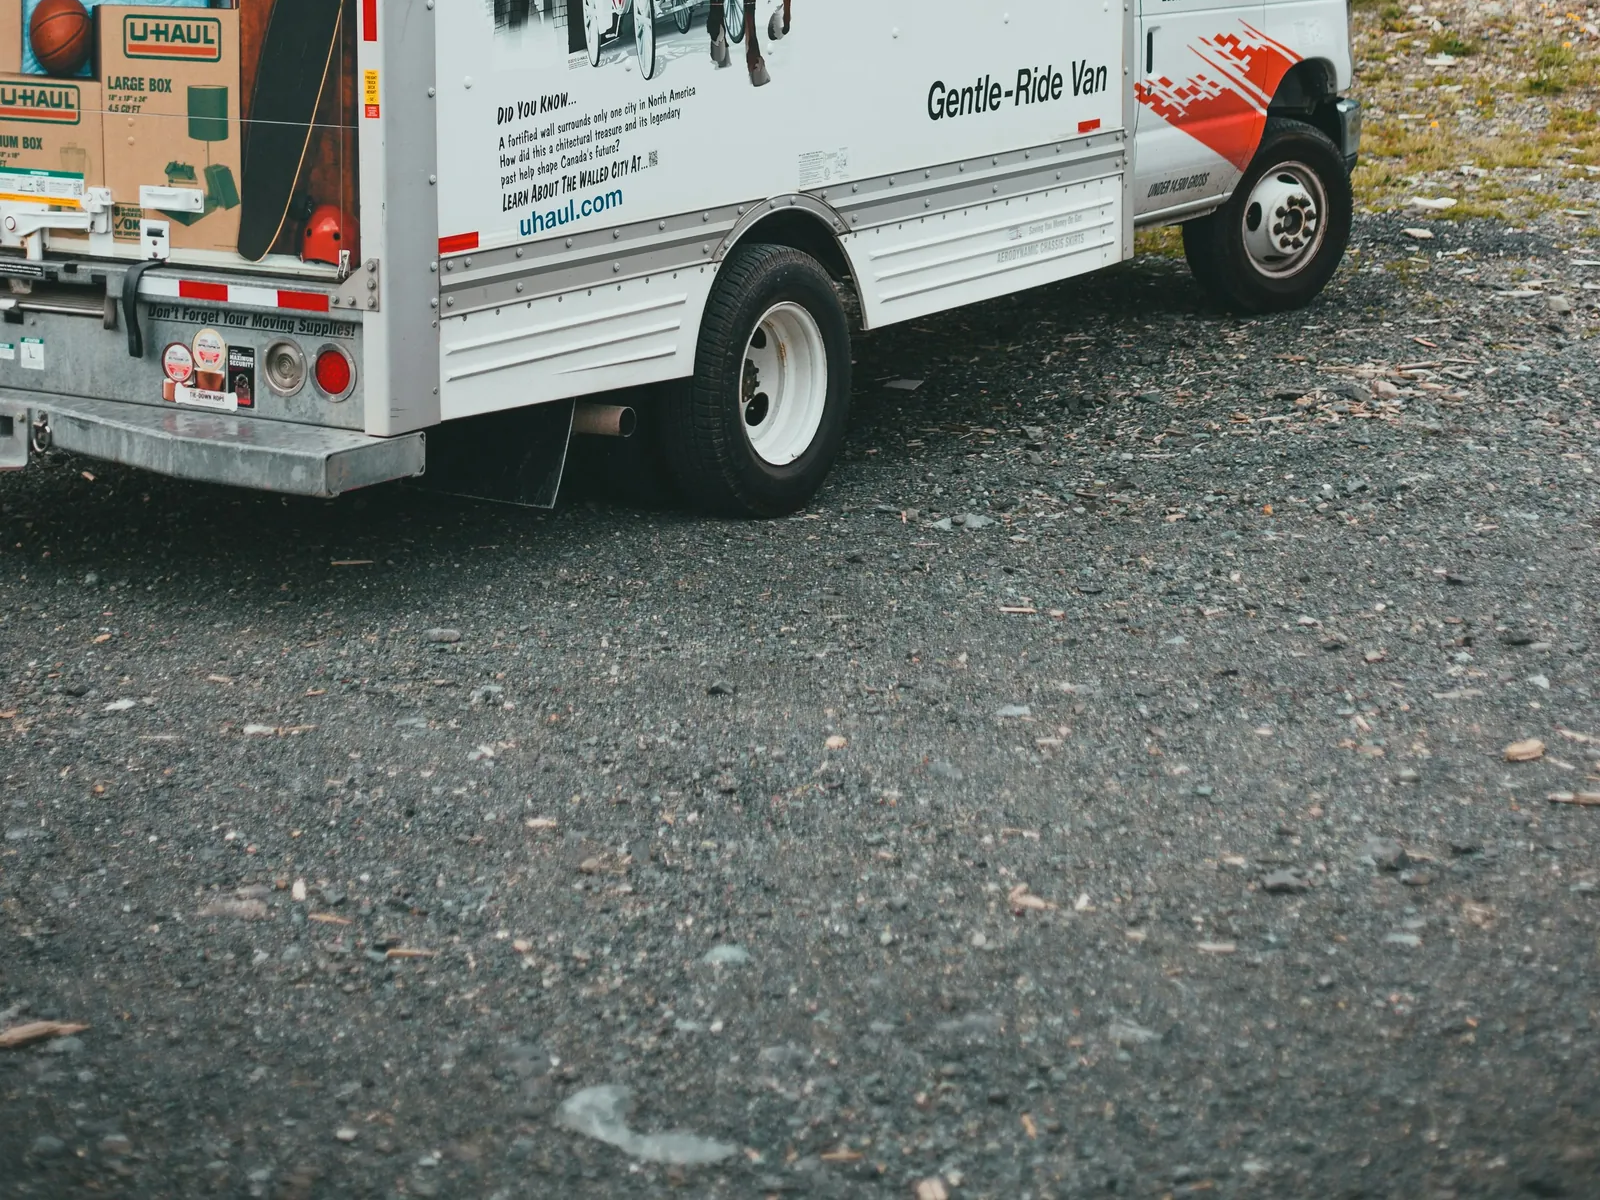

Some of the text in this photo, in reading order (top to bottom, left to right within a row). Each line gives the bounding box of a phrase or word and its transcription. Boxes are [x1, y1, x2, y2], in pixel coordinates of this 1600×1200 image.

[130, 22, 215, 45] U-HAUL
[108, 75, 172, 93] LARGE BOX
[927, 59, 1108, 121] Gentle-Ride Van
[1, 88, 75, 109] U-HAUL
[108, 104, 119, 113] 4.5
[132, 105, 141, 114] FT
[497, 106, 514, 125] DID
[517, 100, 537, 120] YOU
[498, 85, 696, 151] A fortified wall surrounds only one city in North America
[22, 136, 43, 150] BOX
[499, 154, 516, 168] How
[518, 148, 530, 163] did
[532, 145, 546, 159] this
[595, 125, 623, 141] treasure
[625, 120, 637, 132] and
[639, 116, 648, 127] its
[650, 107, 681, 125] legendary
[501, 139, 620, 189] past help shape Canada's future?
[502, 188, 529, 212] LEARN
[531, 180, 559, 203] ABOUT
[561, 175, 577, 194] THE
[579, 166, 609, 189] WALLED
[611, 159, 629, 179] CITY
[1148, 180, 1171, 198] UNDER
[1187, 172, 1210, 189] GROSS
[124, 219, 140, 230] OK
[520, 189, 623, 236] uhaul.com
[997, 233, 1084, 263] AERODYNAMIC CHASSIS SKIRTS
[148, 305, 356, 337] Don't Forget Your Moving Supplies!
[229, 354, 254, 362] MAXIMUM
[229, 360, 254, 368] SECURITY
[190, 391, 212, 400] TIE-DOWN
